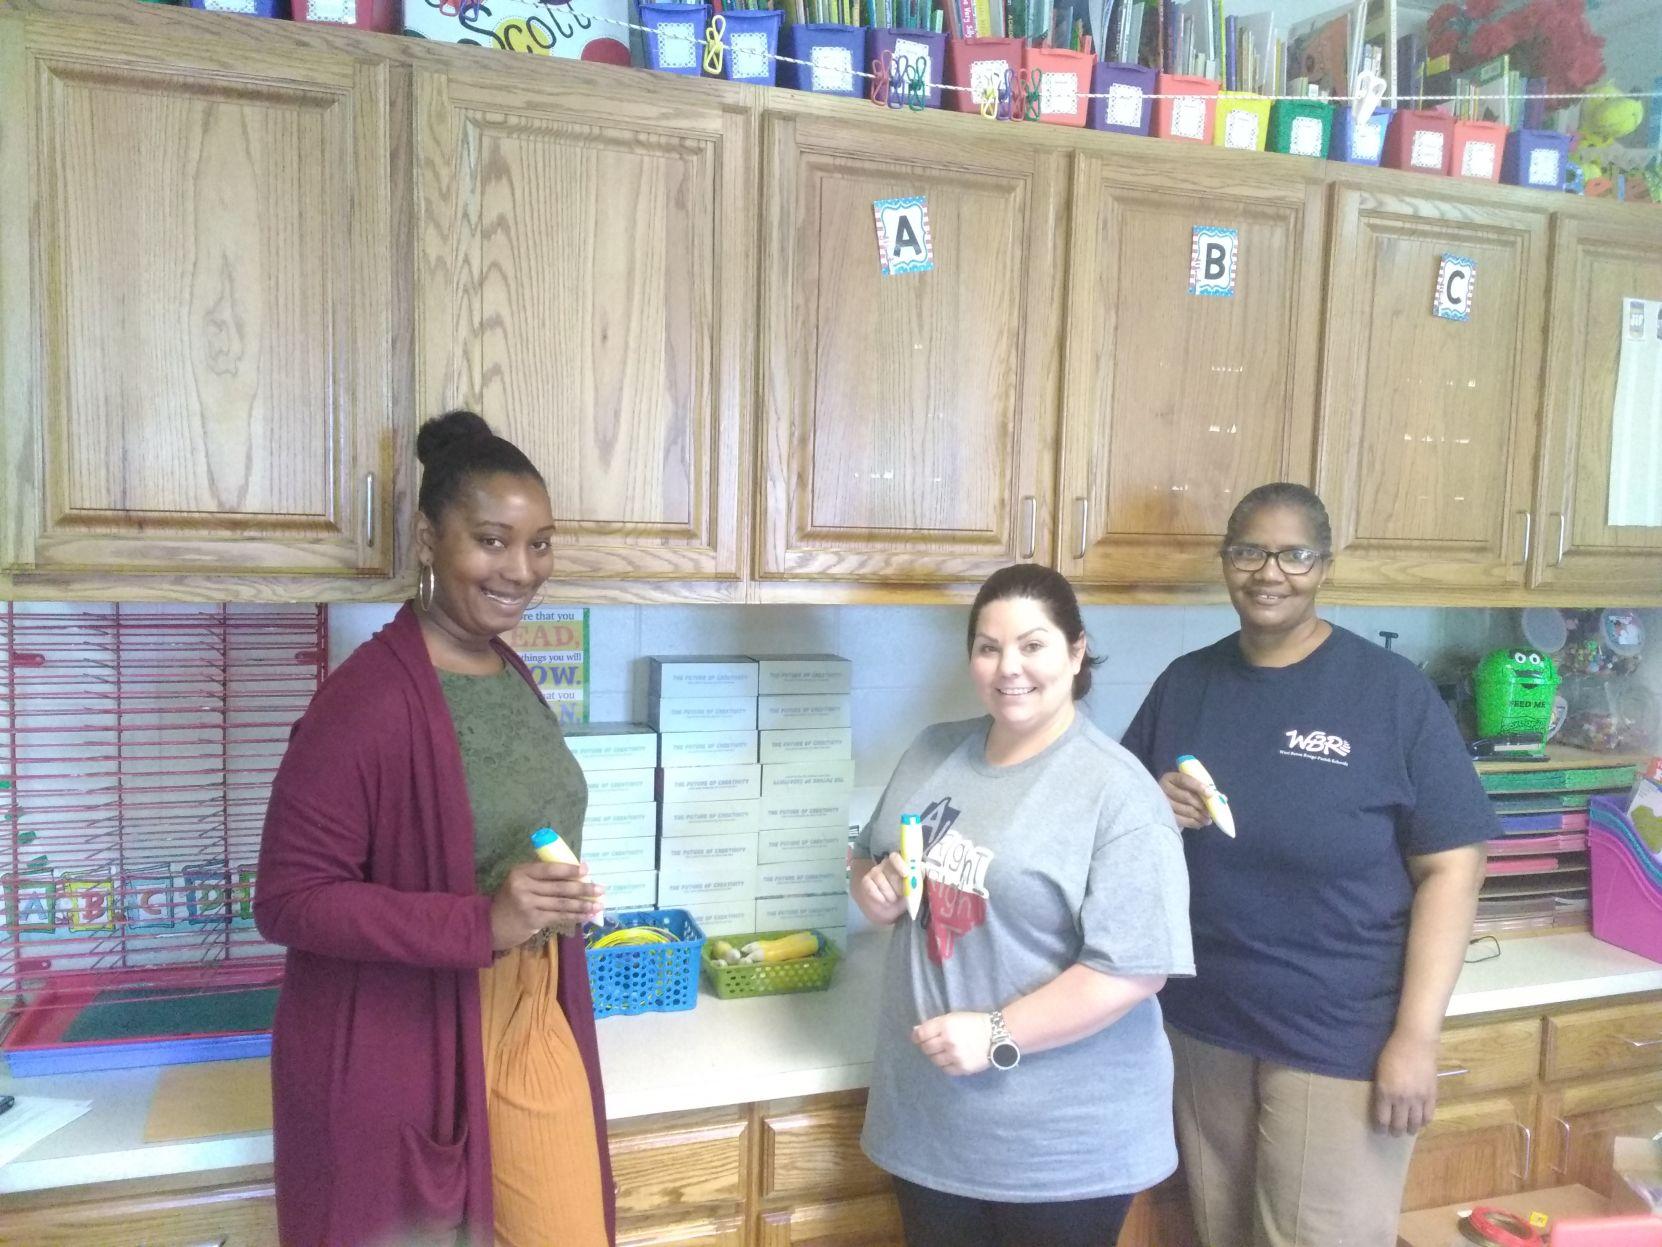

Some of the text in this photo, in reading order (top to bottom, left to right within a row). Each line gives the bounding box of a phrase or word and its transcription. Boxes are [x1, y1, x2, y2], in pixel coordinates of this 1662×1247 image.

[893, 215, 922, 258] A
[1204, 242, 1226, 280] B
[1446, 270, 1465, 304] C
[535, 611, 556, 621] that
[557, 612, 575, 624] you
[510, 624, 580, 649] EAD,
[549, 655, 564, 664] you
[566, 652, 582, 661] will
[530, 665, 582, 687] OW.
[558, 692, 575, 702] you
[1533, 700, 1546, 709] ME
[82, 891, 105, 920] B
